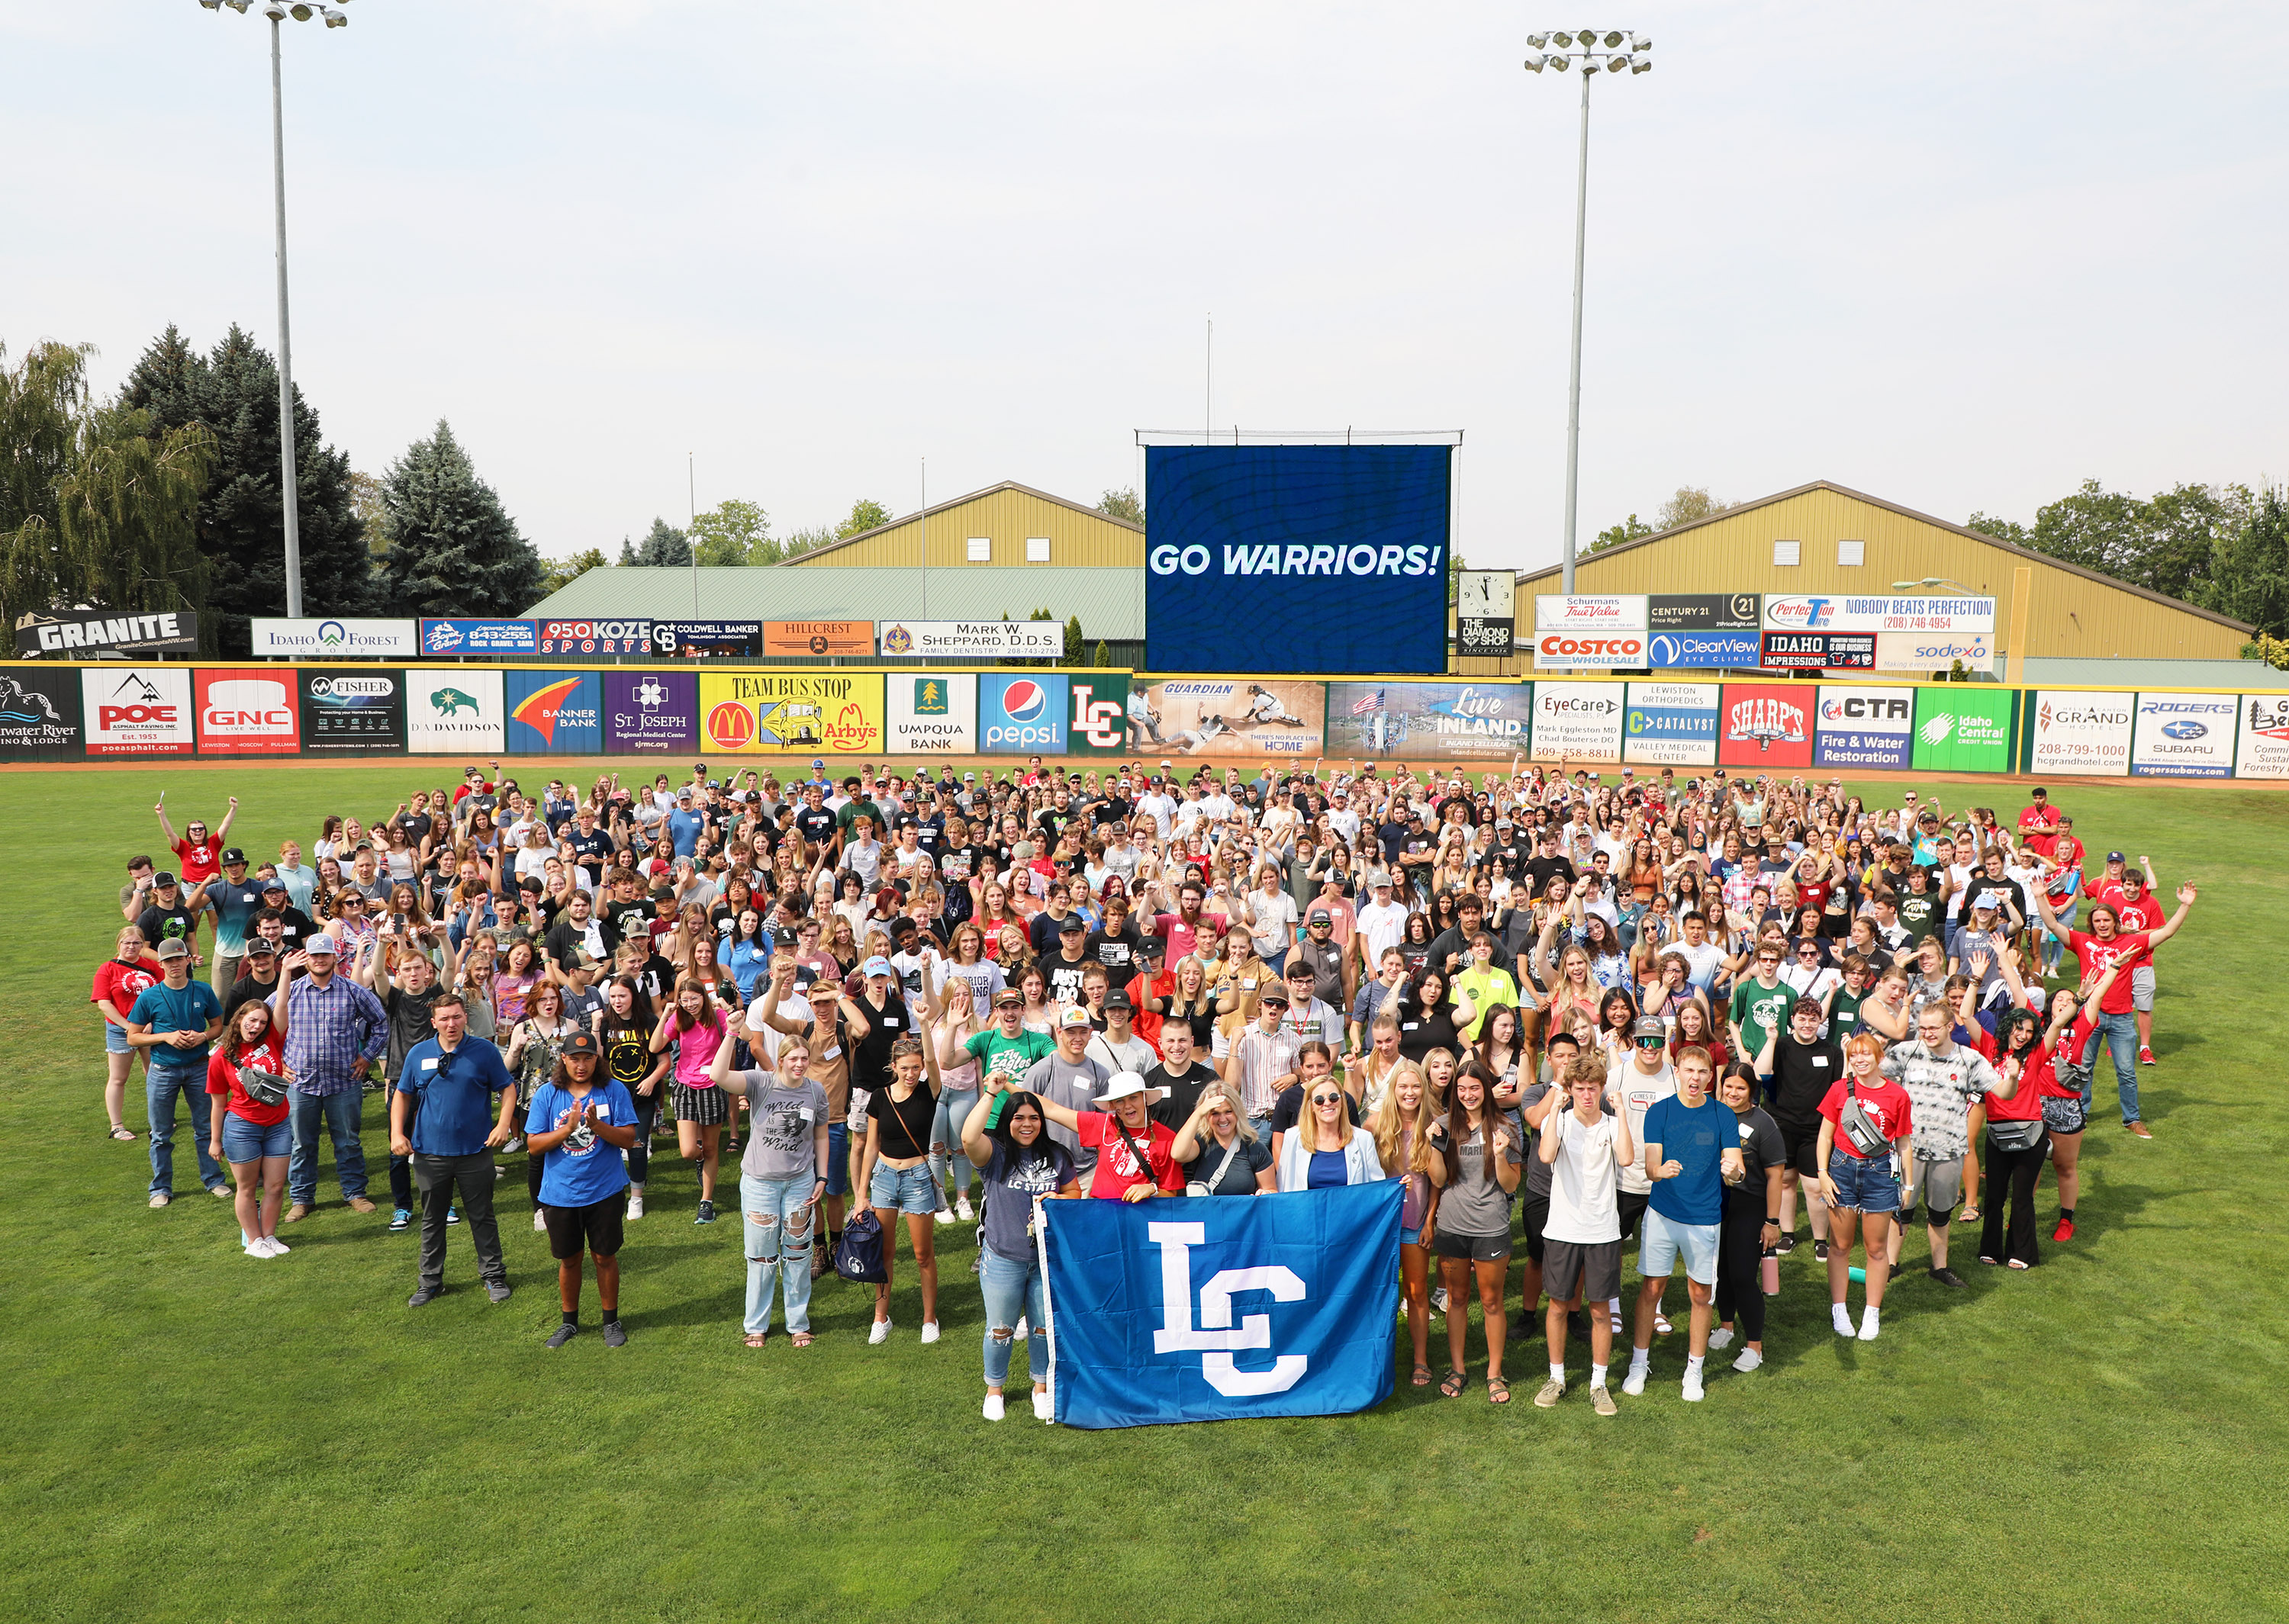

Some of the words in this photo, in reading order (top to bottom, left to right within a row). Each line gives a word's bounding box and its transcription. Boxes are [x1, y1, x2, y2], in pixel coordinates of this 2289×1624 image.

[1150, 544, 1210, 575] GO
[1223, 544, 1441, 575] WARRIORS!
[1651, 607, 1698, 616] CENTURY
[1846, 599, 1888, 613] NOBODY
[1892, 600, 1924, 615] BEATS
[1928, 600, 1991, 616] PERFECTION
[677, 625, 723, 634] COLDWELL
[725, 625, 758, 633] BANKER
[785, 623, 852, 634] HILLCREST
[957, 624, 999, 634] MARK
[1003, 624, 1023, 634] W.
[1463, 619, 1483, 628] THE
[1884, 617, 1908, 629] (208)
[38, 613, 180, 650] GRANITE
[548, 622, 591, 639] 950
[592, 622, 650, 639] KOZE
[1463, 628, 1509, 637] DIAMOND
[115, 636, 194, 650] GraniteConceptsNW.com
[269, 632, 315, 645] IDAHO
[349, 632, 400, 646] FOREST
[433, 635, 465, 651] Gravel
[922, 635, 1006, 647] SHEPPARD,
[1010, 635, 1057, 646] D.D.S.
[1480, 636, 1509, 646] SHOP
[1540, 636, 1641, 655] COSTCO
[1770, 636, 1823, 652] IDAHO
[542, 639, 651, 653] SPORTS
[1682, 639, 1759, 654] ClearView
[1836, 643, 1846, 651] OUR
[1846, 644, 1872, 652] BUSINESS
[1914, 643, 1986, 658] sodexo
[1764, 657, 1827, 666] IMPRESSIONS
[336, 682, 388, 692] FISHER
[732, 677, 773, 699] TEAM
[778, 678, 808, 696] BUS
[813, 678, 852, 699] STOP
[1164, 683, 1234, 694] GUARDIAN
[1451, 687, 1506, 718] Live
[1545, 697, 1604, 716] EyeCare
[1642, 696, 1704, 705] ORTHOPEDICS
[542, 709, 596, 718] BANNER
[1844, 698, 1908, 719] CTR
[2056, 706, 2128, 724] GRAND
[2139, 702, 2236, 715] ROGERS
[98, 704, 177, 731] POE
[208, 711, 288, 725] GNC
[615, 713, 635, 727] ST.
[639, 713, 687, 731] JOSEPH
[1656, 716, 1714, 732] CATALYST
[1730, 698, 1804, 737] SHARP'S
[1959, 716, 1992, 726] Idaho
[42, 724, 76, 737] River
[824, 722, 877, 741] Arby's
[899, 725, 963, 735] UMPQUA
[1437, 717, 1521, 736] INLAND
[1560, 725, 1601, 734] Eggleston
[1958, 727, 2003, 738] Central
[21, 736, 32, 746] &
[987, 722, 1056, 748] pepsi
[635, 741, 668, 749] sjrmc.org
[911, 739, 951, 749] BANK
[1634, 742, 1666, 751] VALLEY
[1669, 743, 1708, 751] MEDICAL
[1821, 735, 1846, 748] Fire
[1849, 736, 1860, 748] &
[1864, 736, 1904, 749] Water
[102, 744, 178, 754] poeasphalt.com
[1536, 747, 1615, 758] 509-758-8811
[2038, 743, 2125, 755] 208-799-1000
[2153, 744, 2213, 754] SUBARU
[1824, 749, 1899, 763] Restoration
[2037, 756, 2124, 767] hcgrandhotel.com
[2139, 766, 2225, 775] rogerssubaru.com
[2244, 763, 2285, 774] Forestry
[1052, 968, 1084, 987] JUST
[1056, 986, 1079, 1002] DO
[1003, 1049, 1018, 1061] Fly
[989, 1053, 1032, 1072] Eagles
[765, 1101, 800, 1113] Wild
[766, 1117, 775, 1125] AS
[762, 1136, 803, 1153] Wind
[1007, 1179, 1022, 1190] LC
[1023, 1181, 1057, 1192] STATE
[1148, 1221, 1307, 1397] LC
